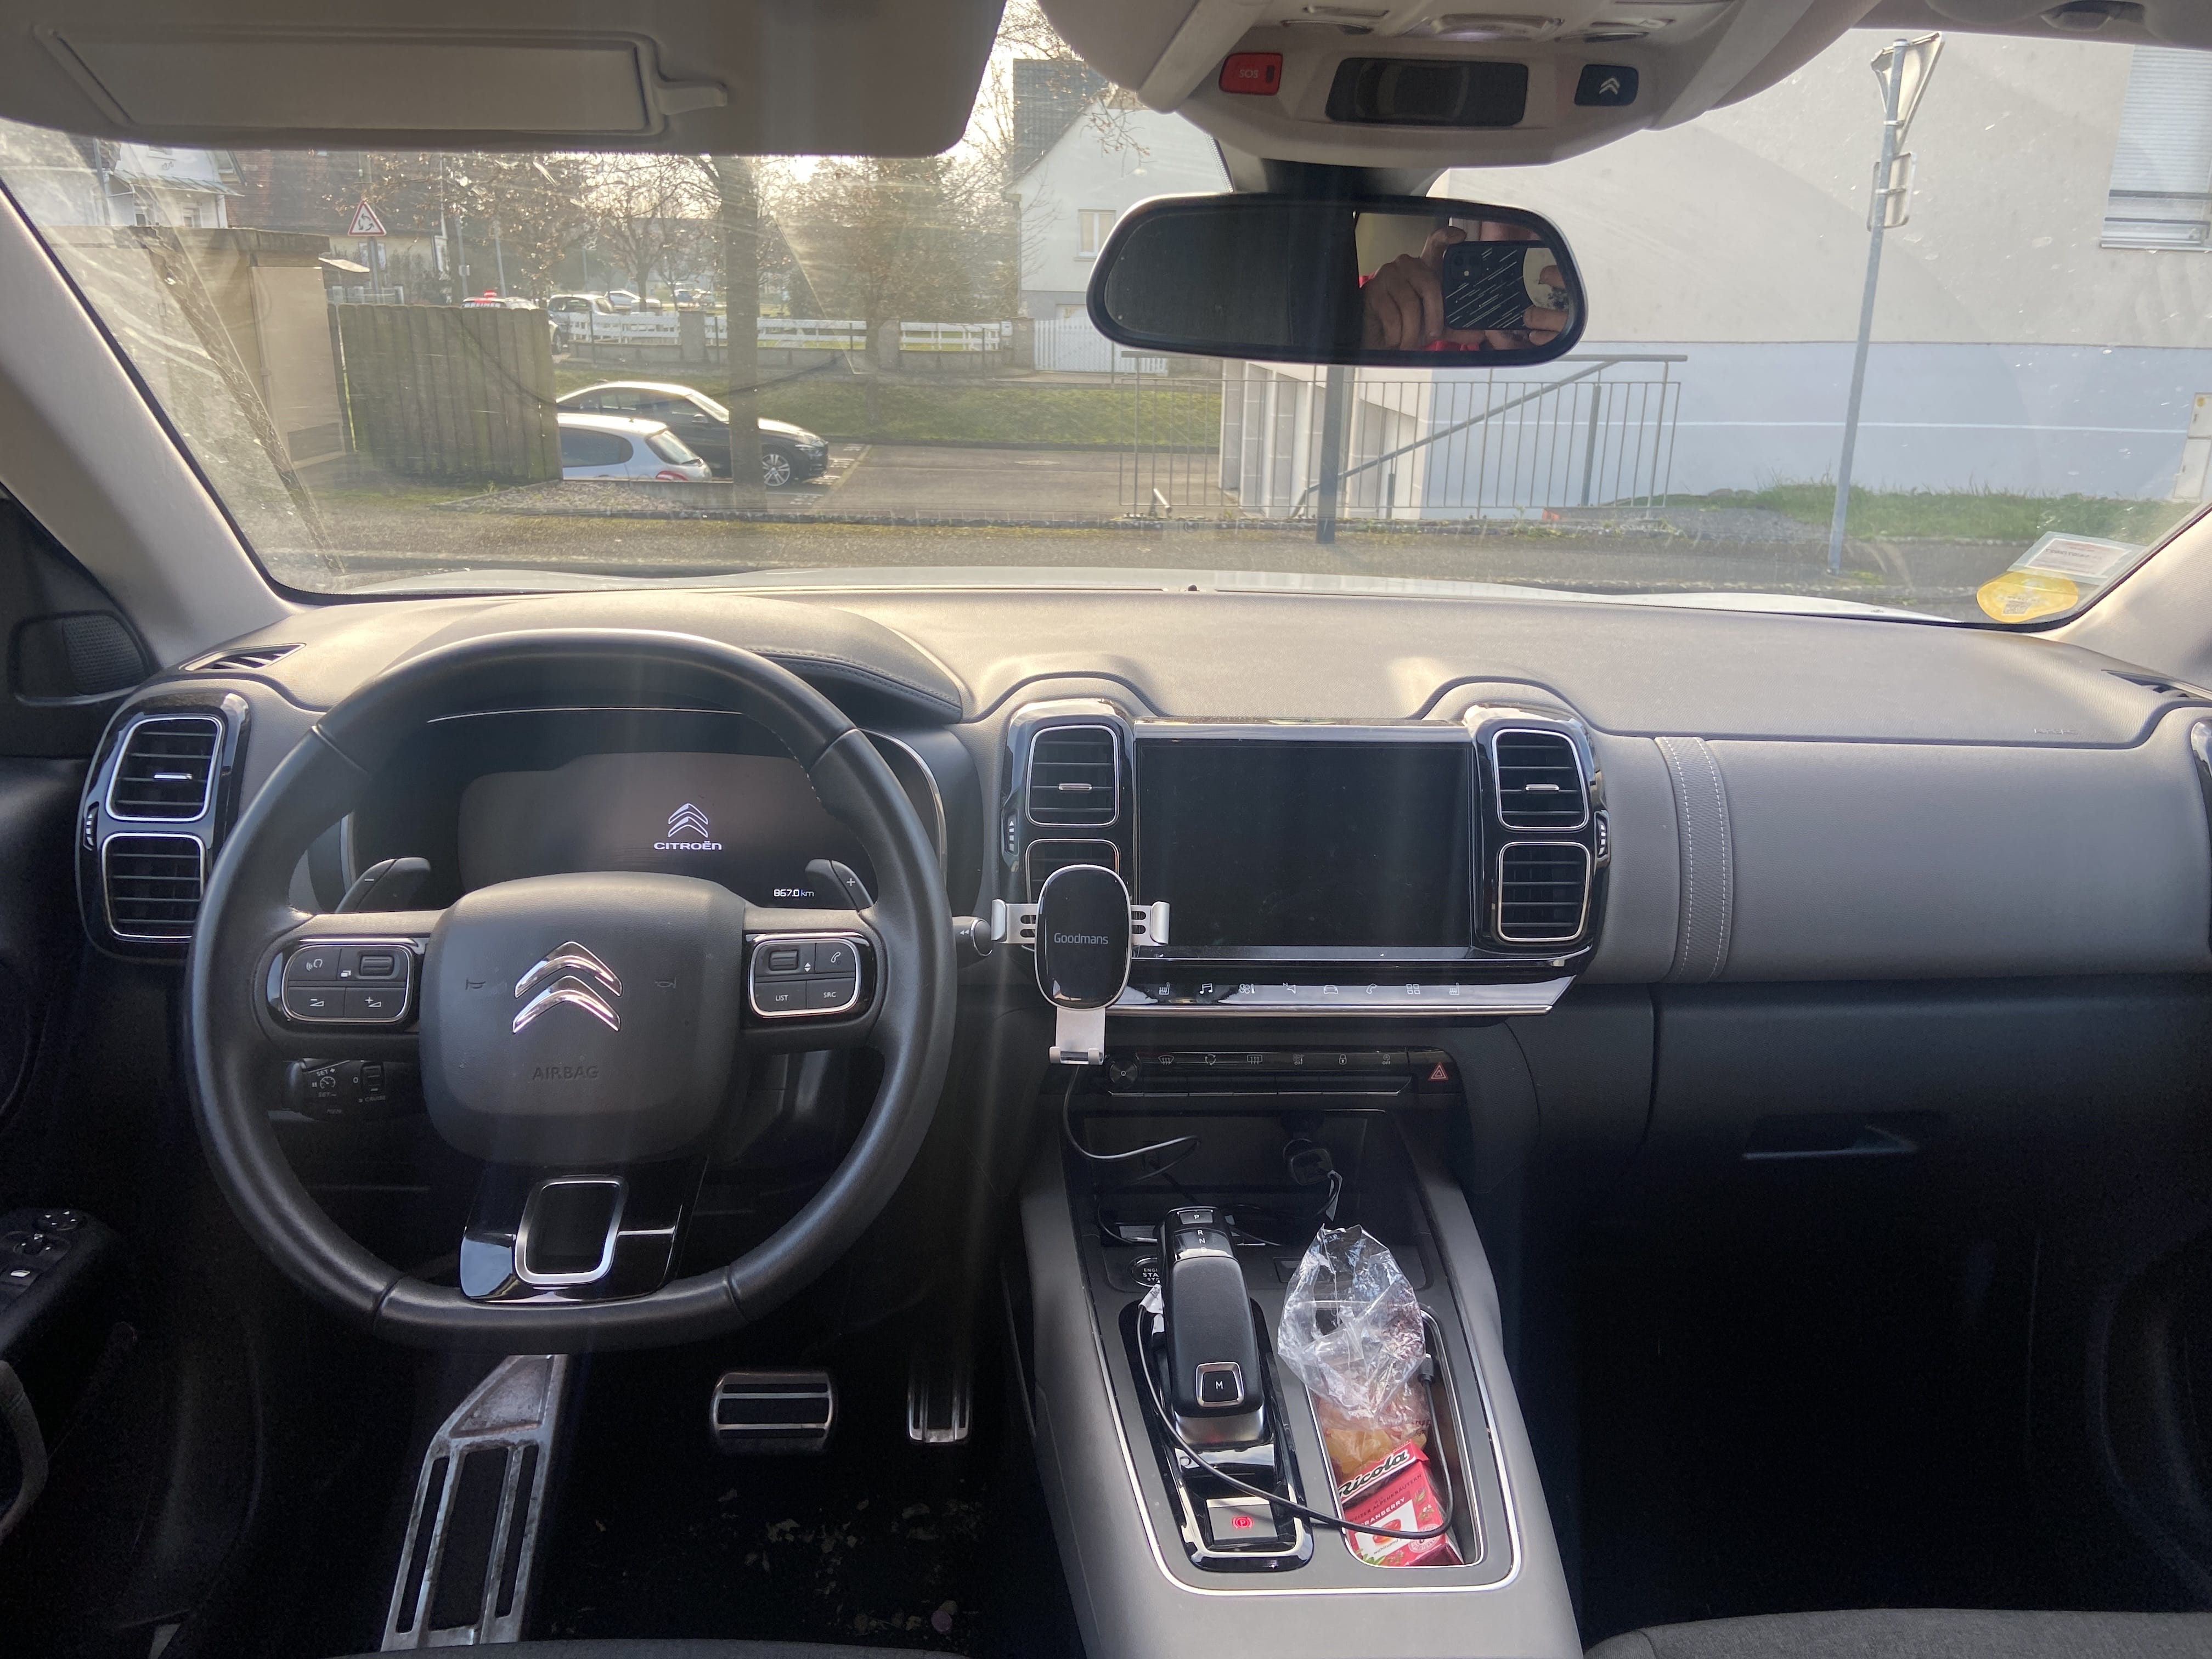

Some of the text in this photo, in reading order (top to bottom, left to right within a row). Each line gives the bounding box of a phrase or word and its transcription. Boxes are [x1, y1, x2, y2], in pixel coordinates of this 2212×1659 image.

[1239, 70, 1259, 78] SOS
[1054, 933, 1108, 945] Goodmans
[532, 1065, 599, 1080] AIRBAG
[1215, 1381, 1223, 1389] M
[1338, 1450, 1409, 1497] Ricola
[1373, 1474, 1422, 1510] ALPENKRÄUTERN
